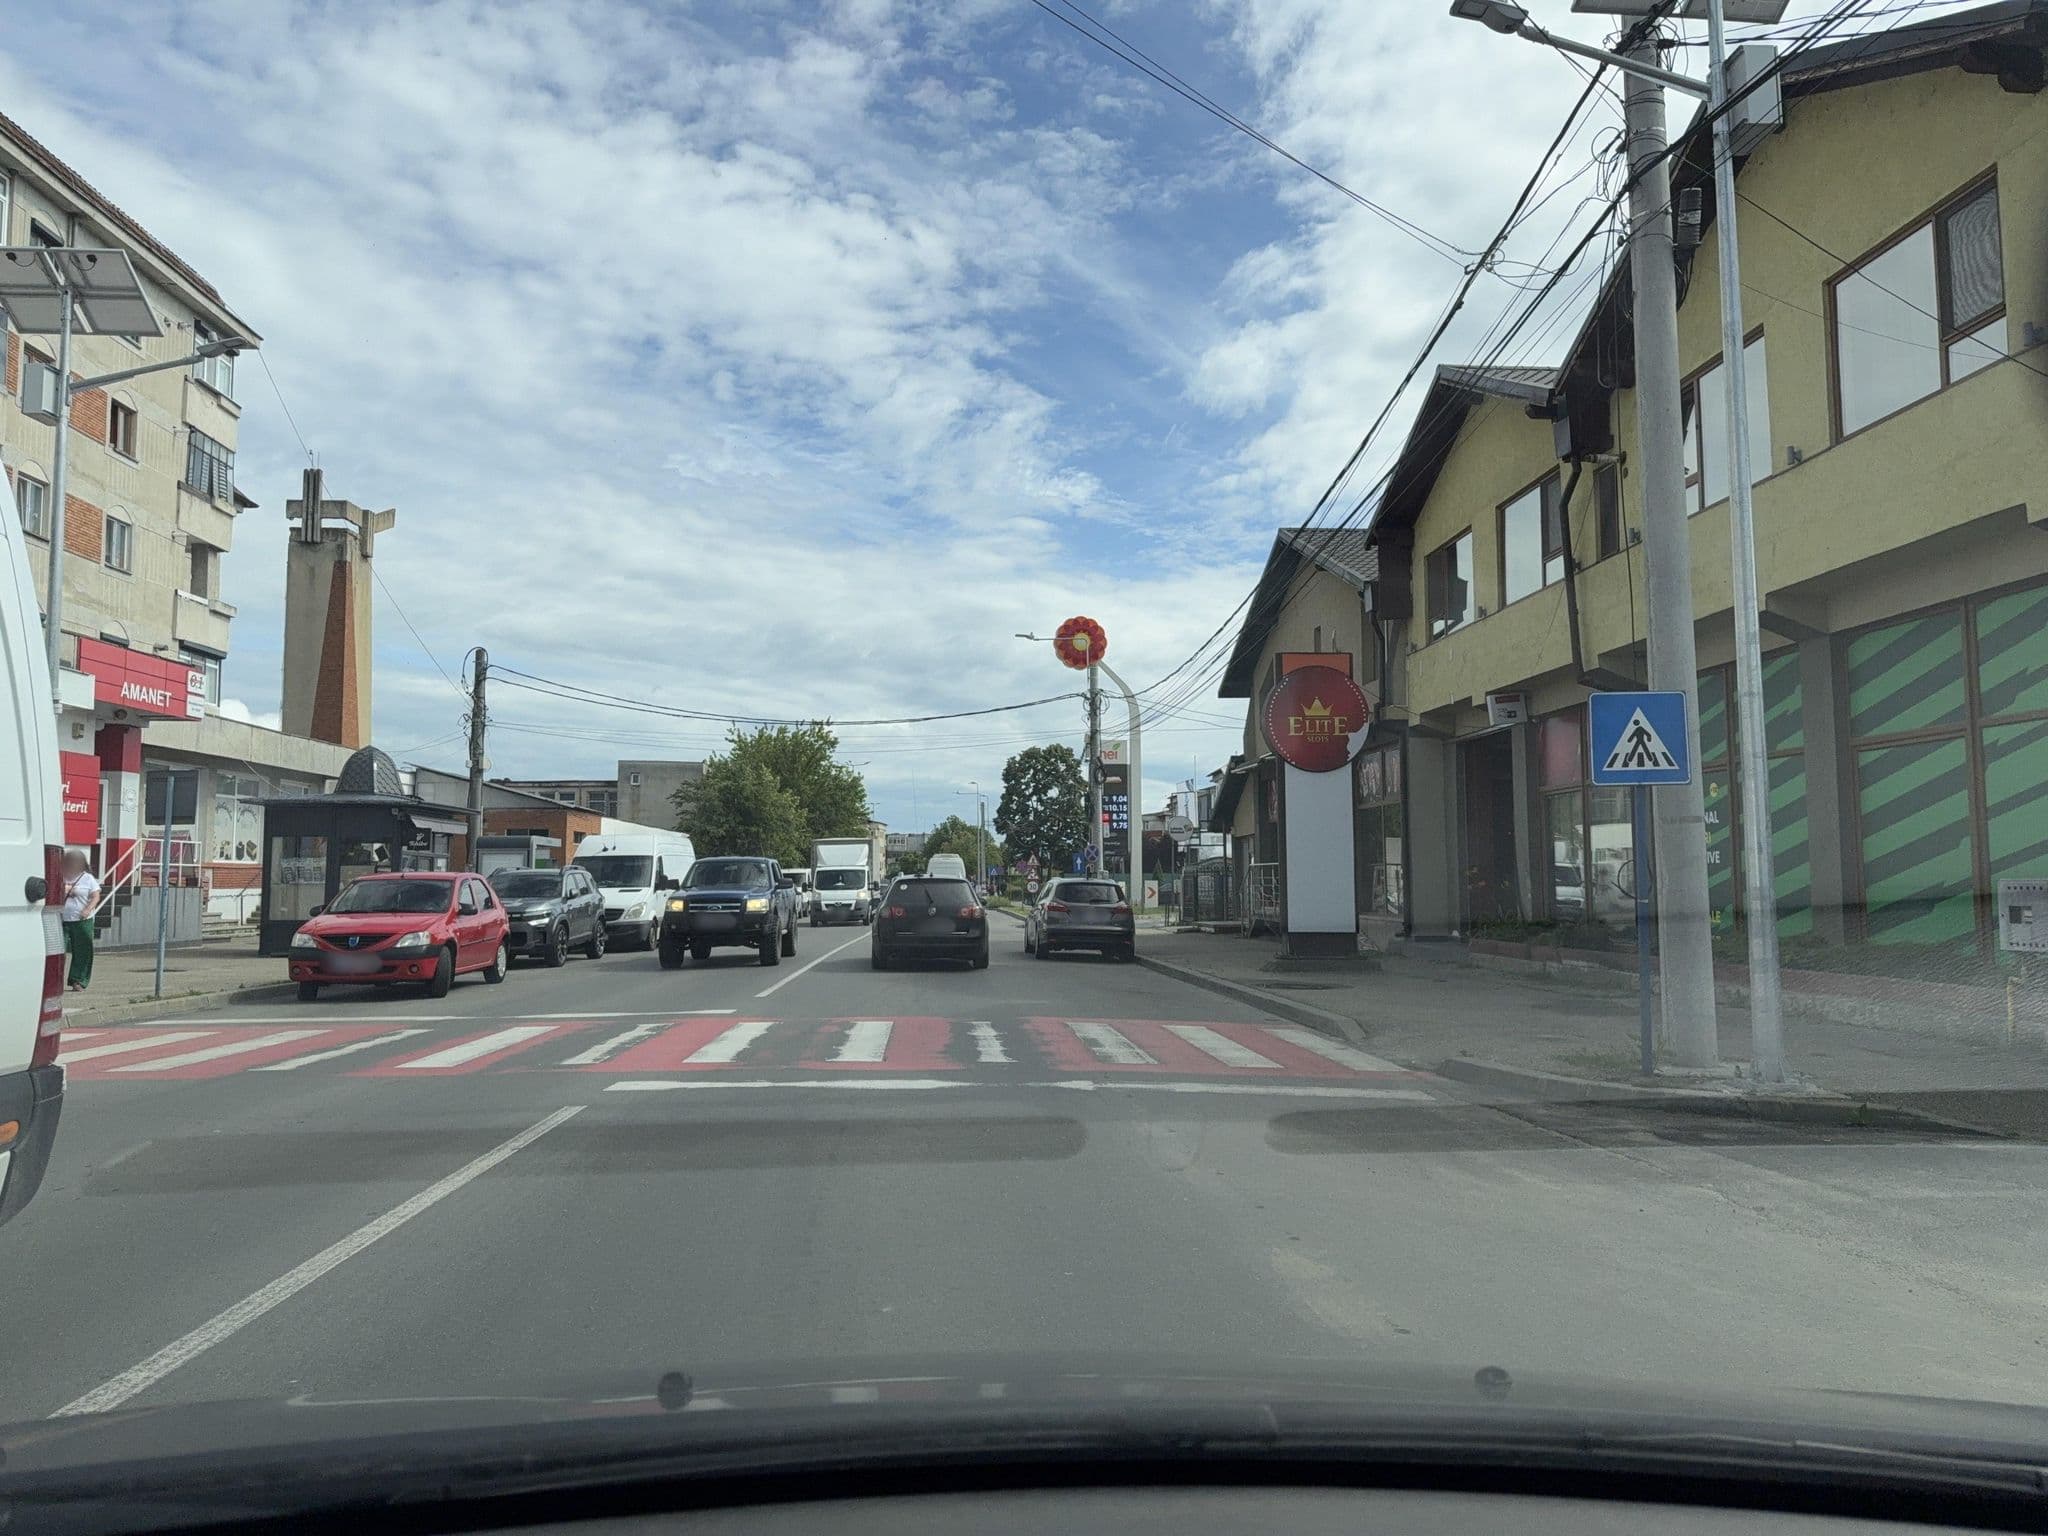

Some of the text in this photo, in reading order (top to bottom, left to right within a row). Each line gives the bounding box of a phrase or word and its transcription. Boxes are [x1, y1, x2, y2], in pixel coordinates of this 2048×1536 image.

[121, 681, 172, 708] AMANET
[1288, 716, 1348, 736] ELITE
[1109, 804, 1128, 812] 10.15
